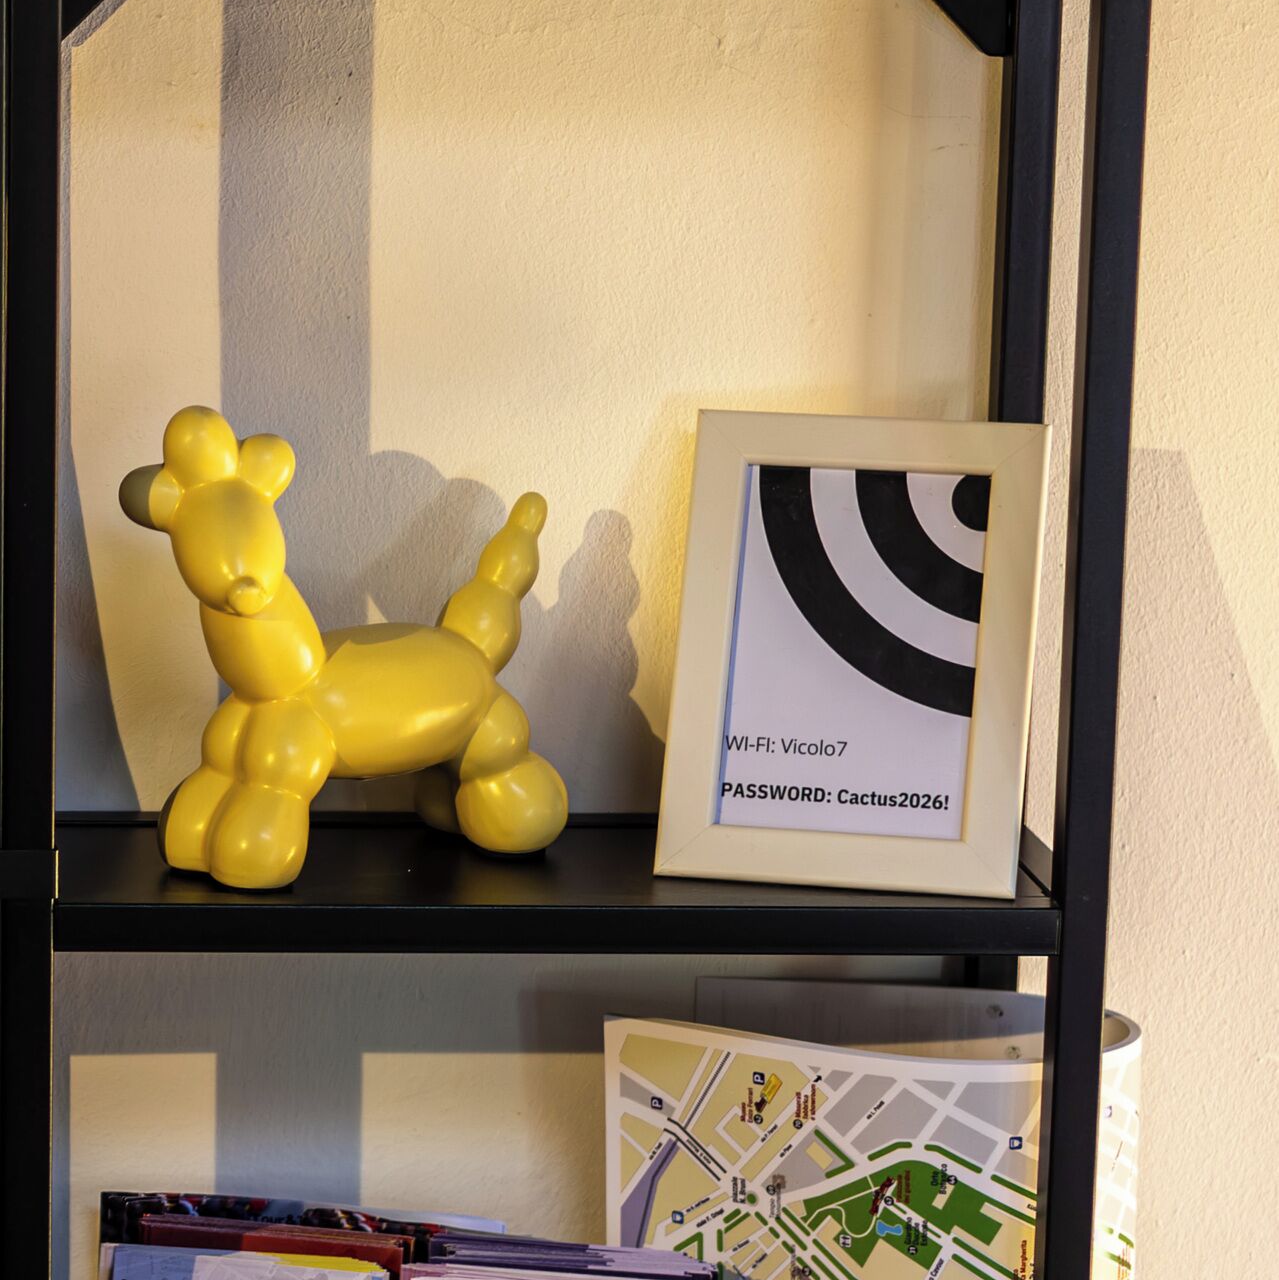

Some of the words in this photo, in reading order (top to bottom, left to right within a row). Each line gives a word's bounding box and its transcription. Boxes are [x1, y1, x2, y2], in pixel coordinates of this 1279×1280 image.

[726, 735, 775, 754] WI-FI:
[781, 738, 847, 757] Vicolo7
[721, 783, 832, 803] PASSWORD:
[837, 788, 949, 810] Cactus2026!
